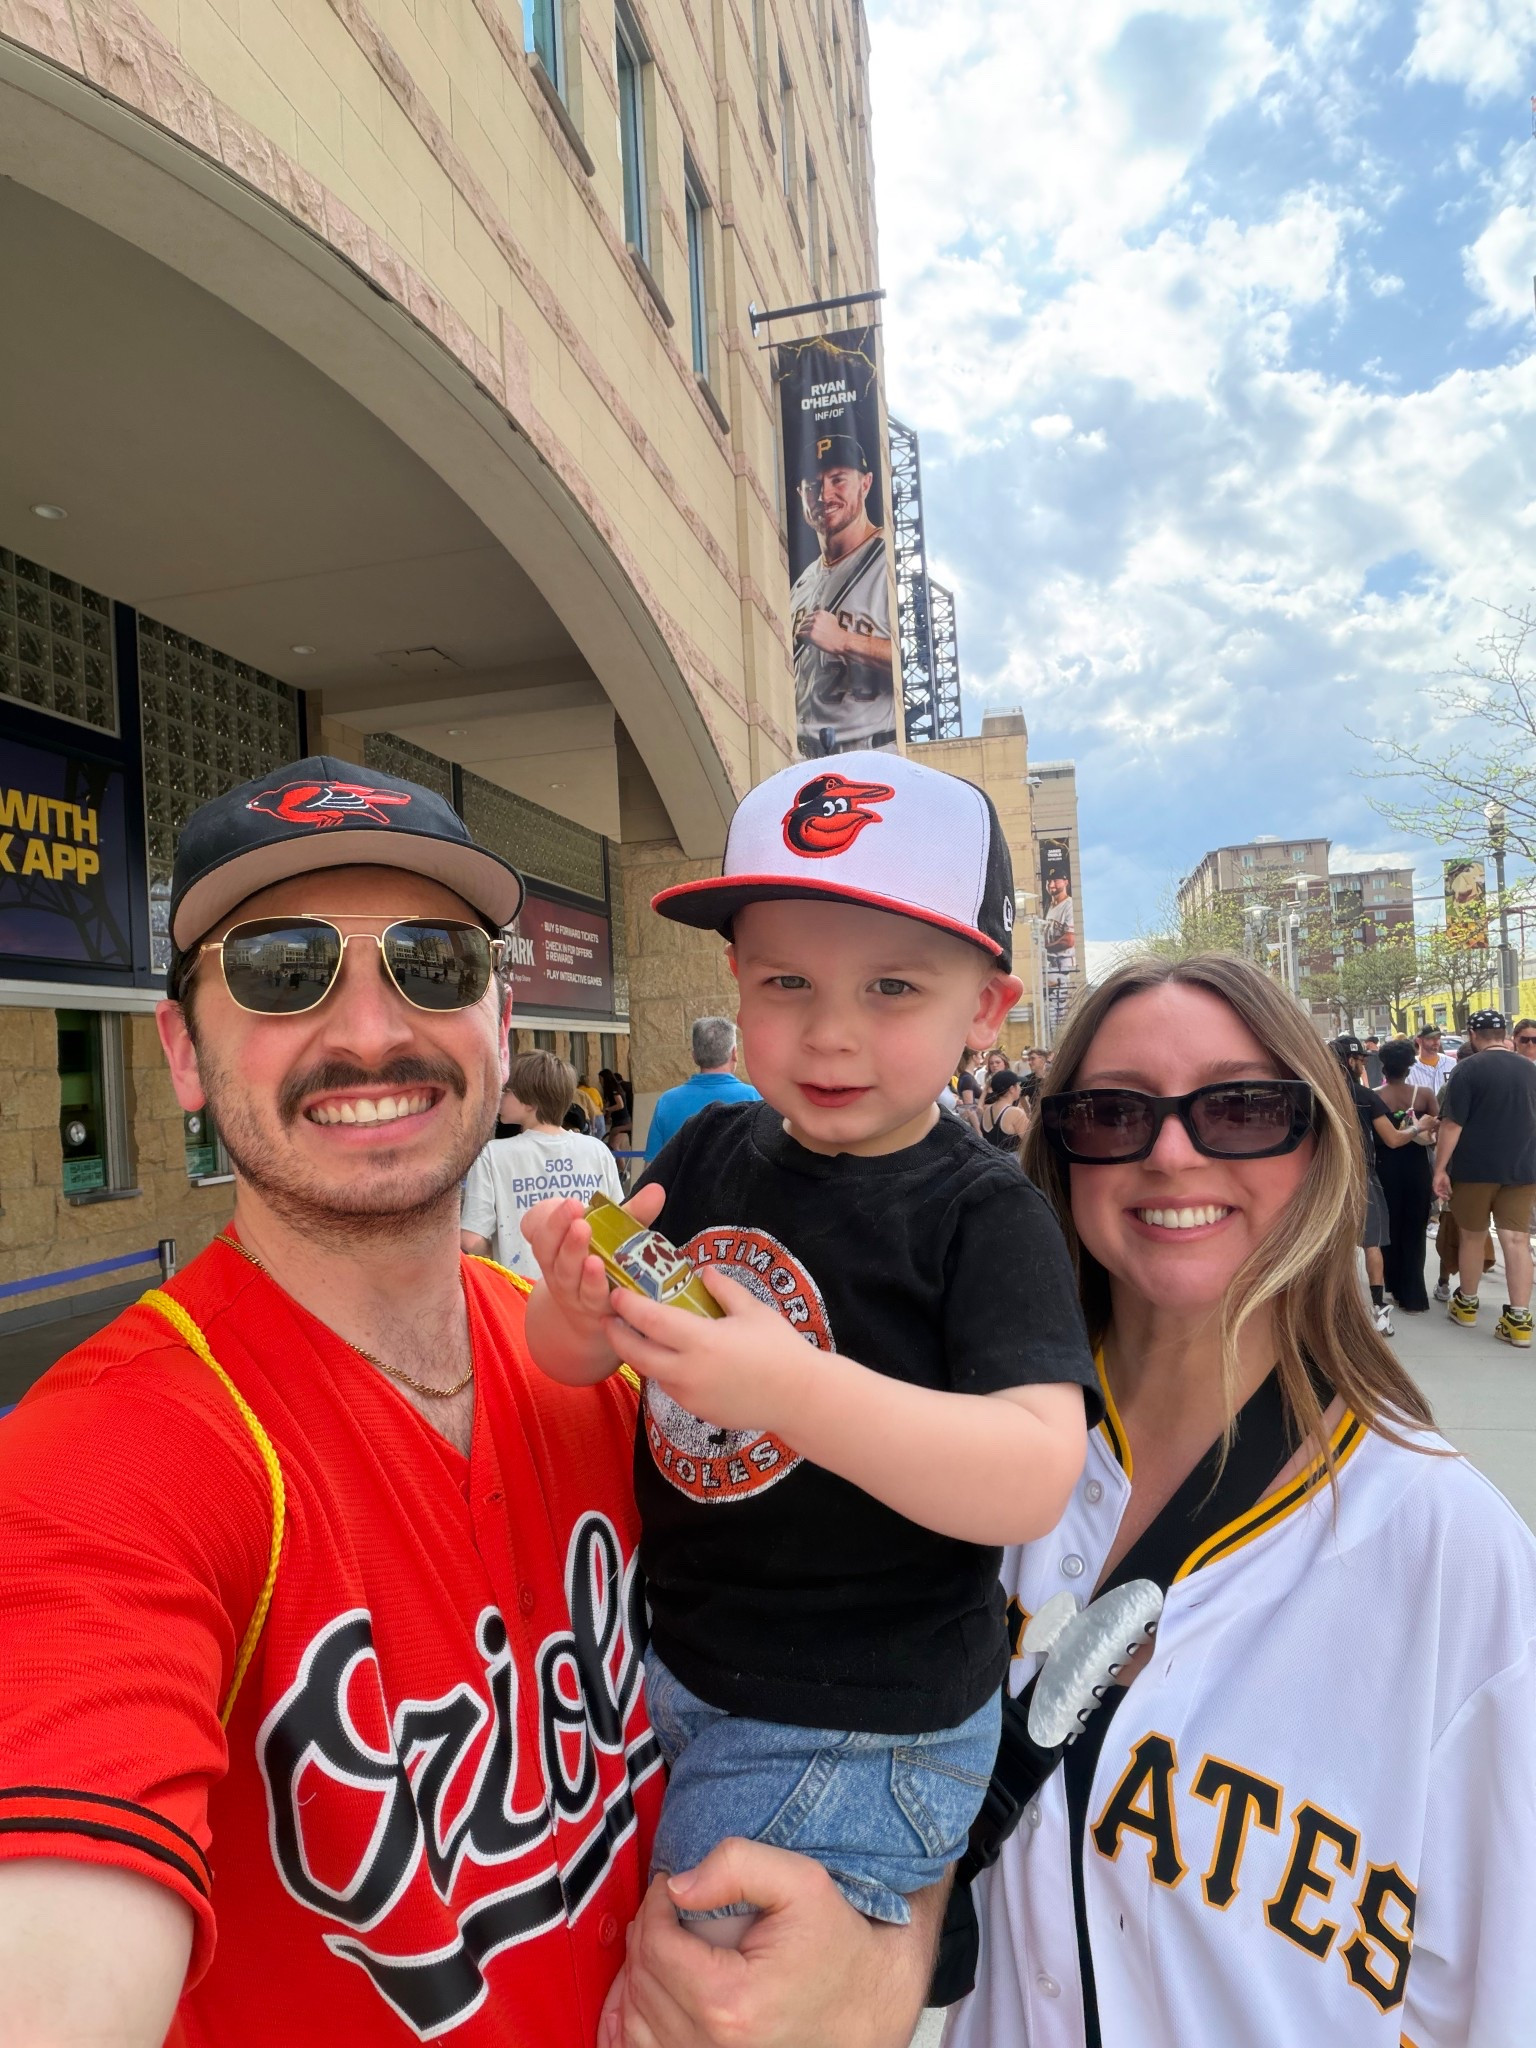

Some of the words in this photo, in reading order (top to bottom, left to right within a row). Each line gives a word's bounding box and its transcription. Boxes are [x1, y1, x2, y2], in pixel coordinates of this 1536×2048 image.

[811, 380, 846, 396] RYAN
[801, 390, 857, 410] O'HEARN
[815, 408, 844, 421] INF/OF
[817, 438, 832, 460] P
[0, 787, 98, 846] WITH
[22, 838, 100, 885] APP
[544, 922, 555, 934] BUY
[560, 925, 581, 939] FORWARD
[581, 930, 599, 944] TICKETS
[504, 934, 536, 967] PARK
[545, 940, 562, 952] CHECK
[562, 943, 567, 953] IN
[568, 944, 576, 955] FOR
[576, 947, 593, 959] OFFERS
[550, 952, 574, 965] REWARDS
[546, 969, 560, 980] PLAY
[560, 971, 587, 985] INTERACTIVE
[588, 976, 602, 987] GAMES
[545, 1158, 574, 1173] 503
[512, 1174, 603, 1193] BROADWAY
[685, 1239, 820, 1349] LTIMOR
[651, 1423, 781, 1489] RIOLES
[1090, 1730, 1418, 2016] ATES
